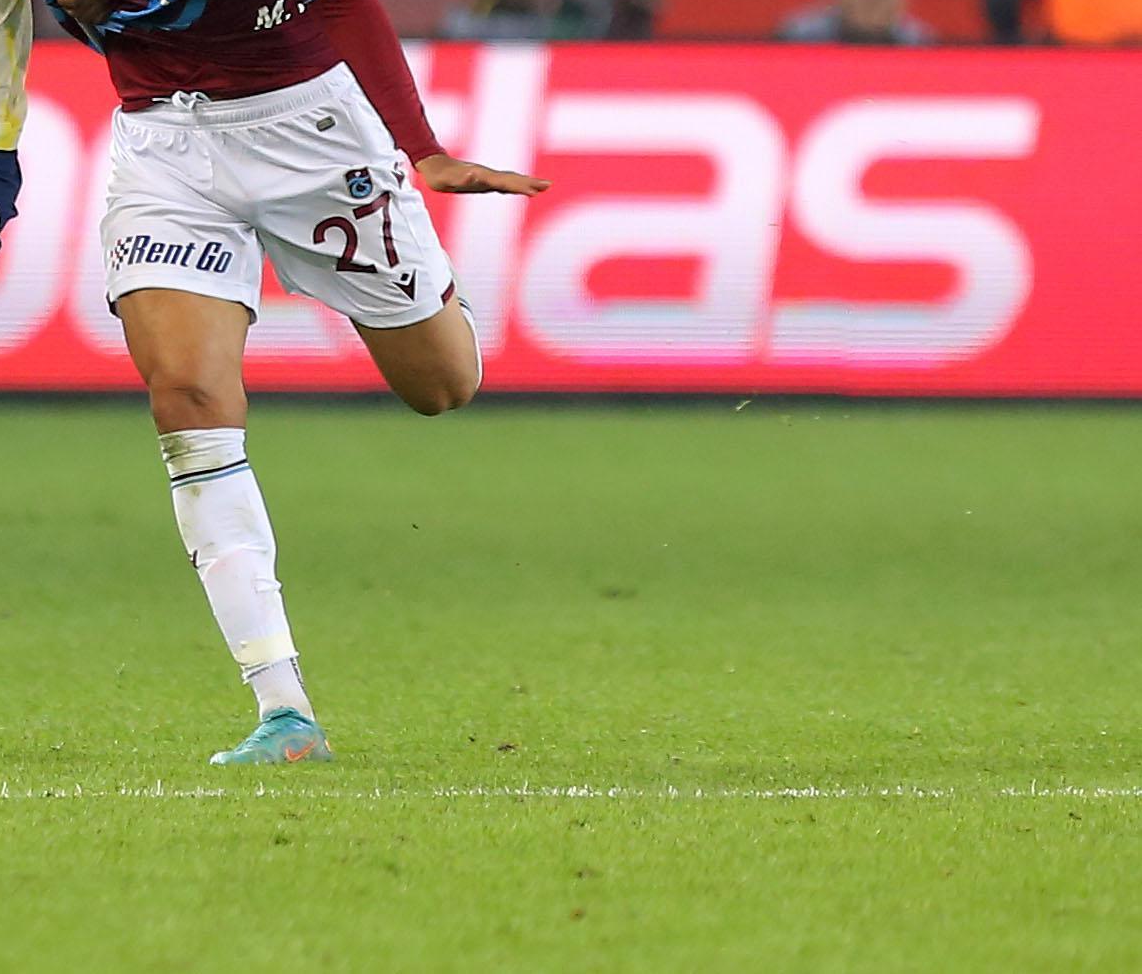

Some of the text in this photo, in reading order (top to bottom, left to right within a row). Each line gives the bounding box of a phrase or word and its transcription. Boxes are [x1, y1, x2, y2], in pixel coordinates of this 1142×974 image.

[127, 234, 234, 273] Rent Go
[313, 191, 400, 274] 27
